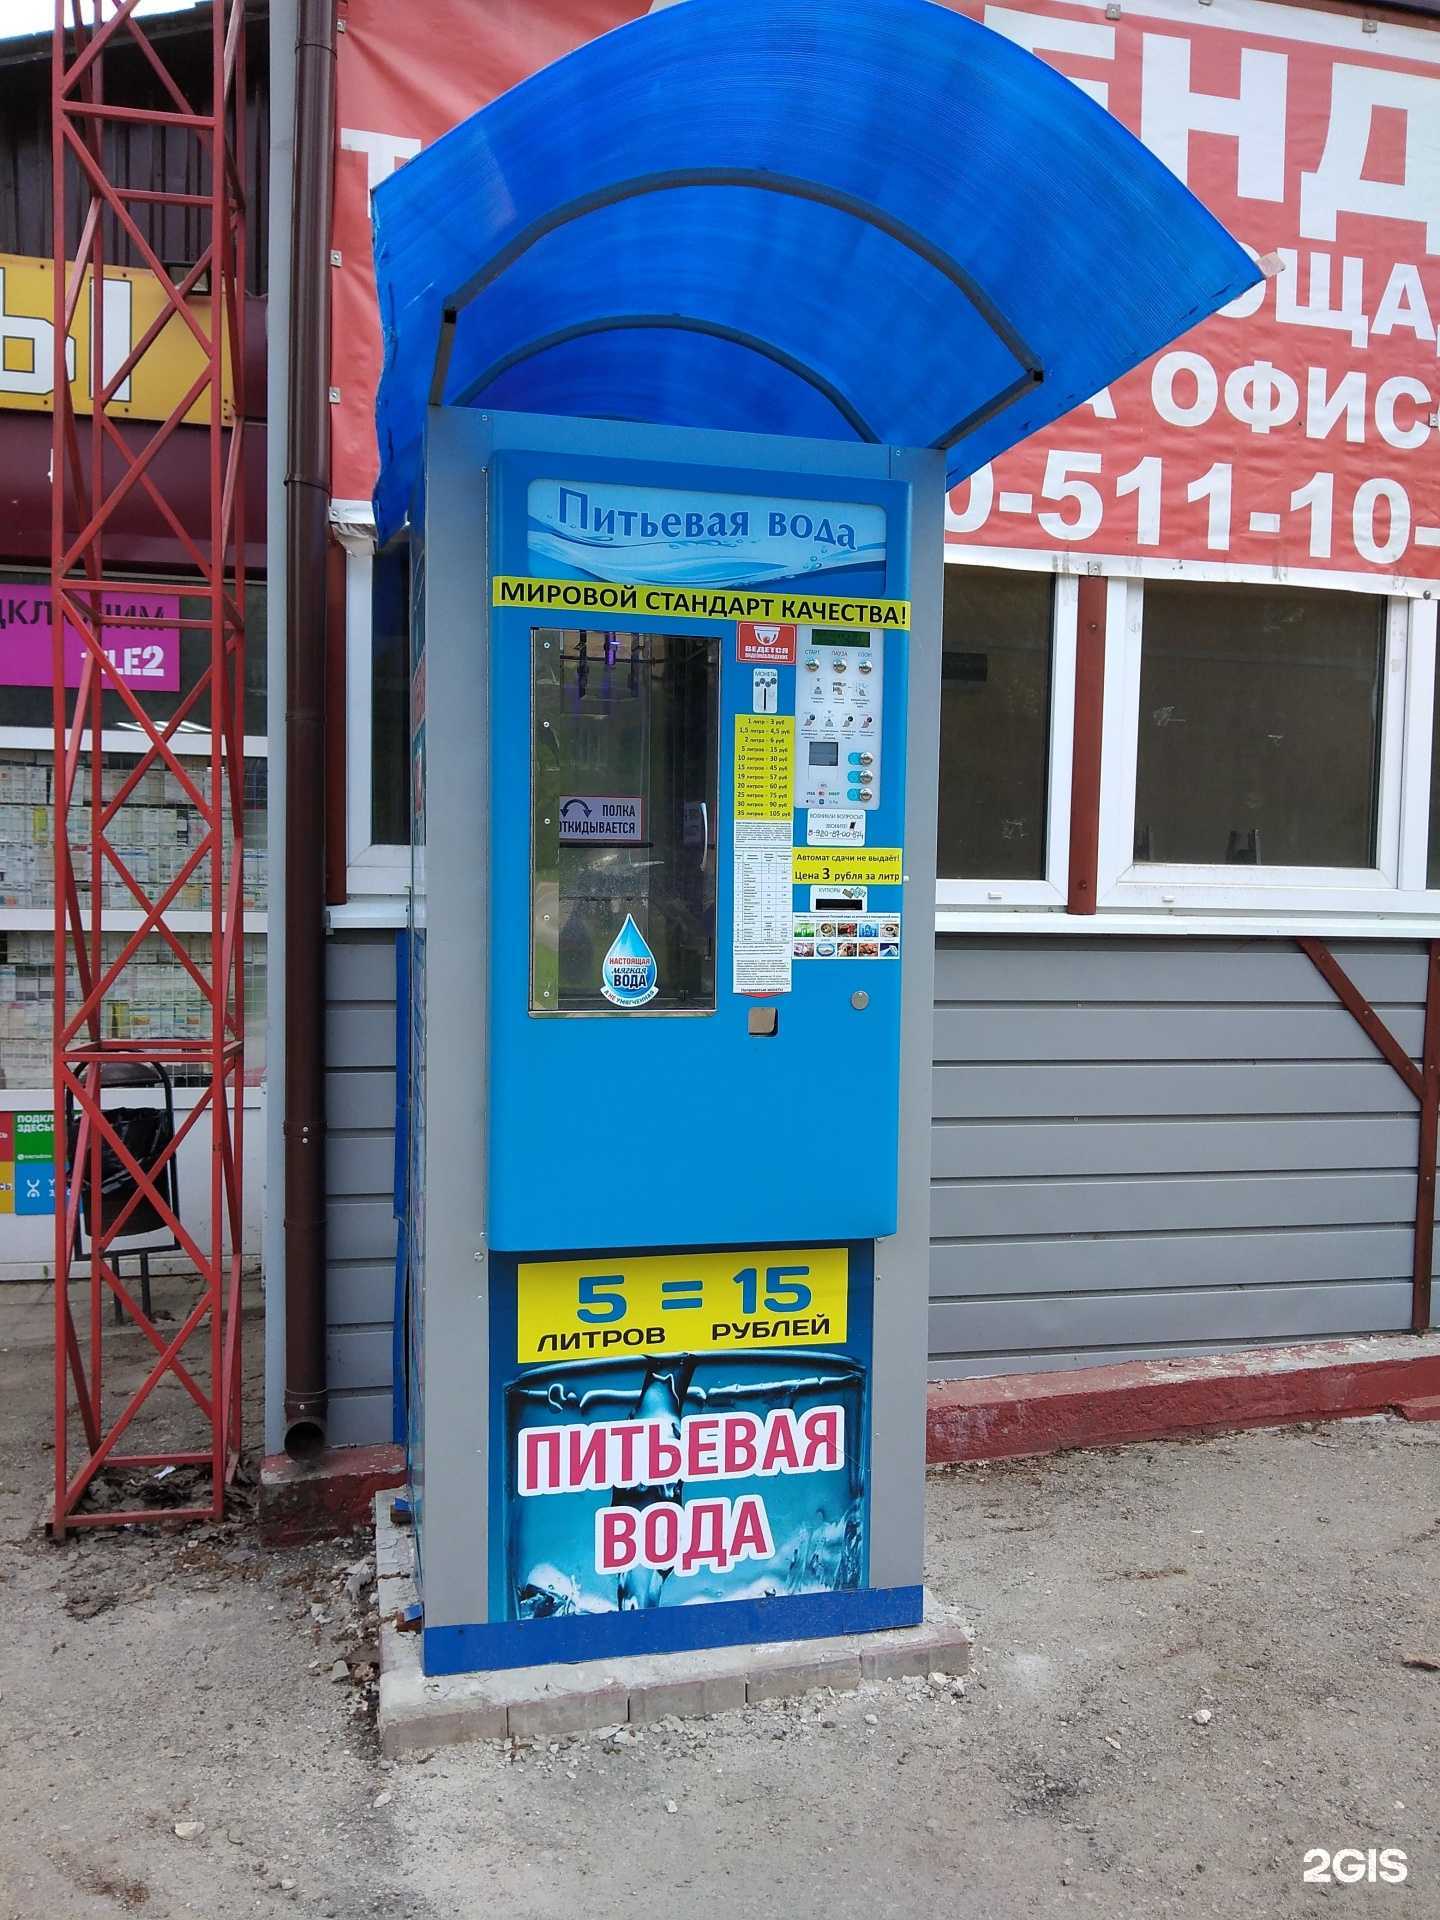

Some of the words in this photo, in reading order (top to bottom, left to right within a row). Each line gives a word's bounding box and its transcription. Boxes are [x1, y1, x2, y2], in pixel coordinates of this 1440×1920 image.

[558, 487, 749, 538] Питьевая
[768, 512, 858, 551] вода
[501, 579, 638, 609] МИРОВОЙ
[645, 591, 774, 619] СТАНДАРТ
[782, 600, 907, 625] КАЧЕСТВА!
[745, 645, 789, 655] ВЕДЕТСЯ
[602, 804, 636, 818] ПОЛКА
[797, 854, 830, 862] Автомат
[795, 871, 820, 881] Цена
[822, 868, 830, 880] 3
[834, 871, 863, 882] рубля
[878, 873, 900, 882] литр
[609, 957, 650, 965] НАСТОЯЩАЯ
[612, 967, 647, 975] мягкая
[613, 974, 646, 988] ВОДА
[577, 1275, 627, 1324] 5
[732, 1266, 812, 1314] 15
[536, 1327, 666, 1353] ЛИТРОВ
[711, 1313, 830, 1341] РУБЛЕЙ
[525, 1411, 838, 1490] ПИТЬЕВАЯ
[602, 1500, 768, 1571] ВОДА
